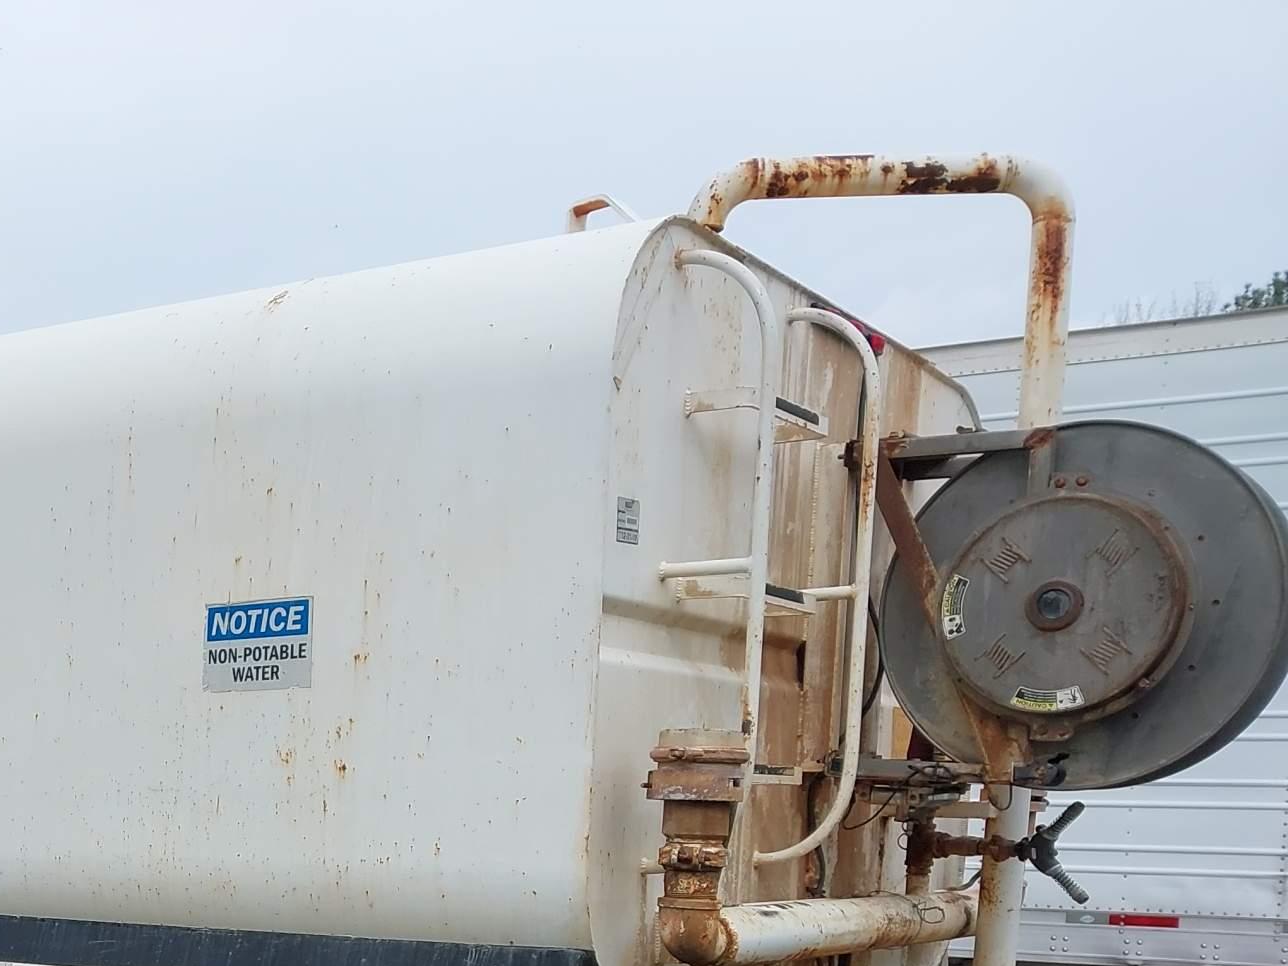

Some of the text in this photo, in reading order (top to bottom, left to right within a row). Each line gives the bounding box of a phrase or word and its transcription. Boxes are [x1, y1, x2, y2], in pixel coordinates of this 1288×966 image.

[212, 605, 305, 636] NOTICE
[208, 643, 307, 665] NON-POTABLE
[232, 665, 280, 682] WATER
